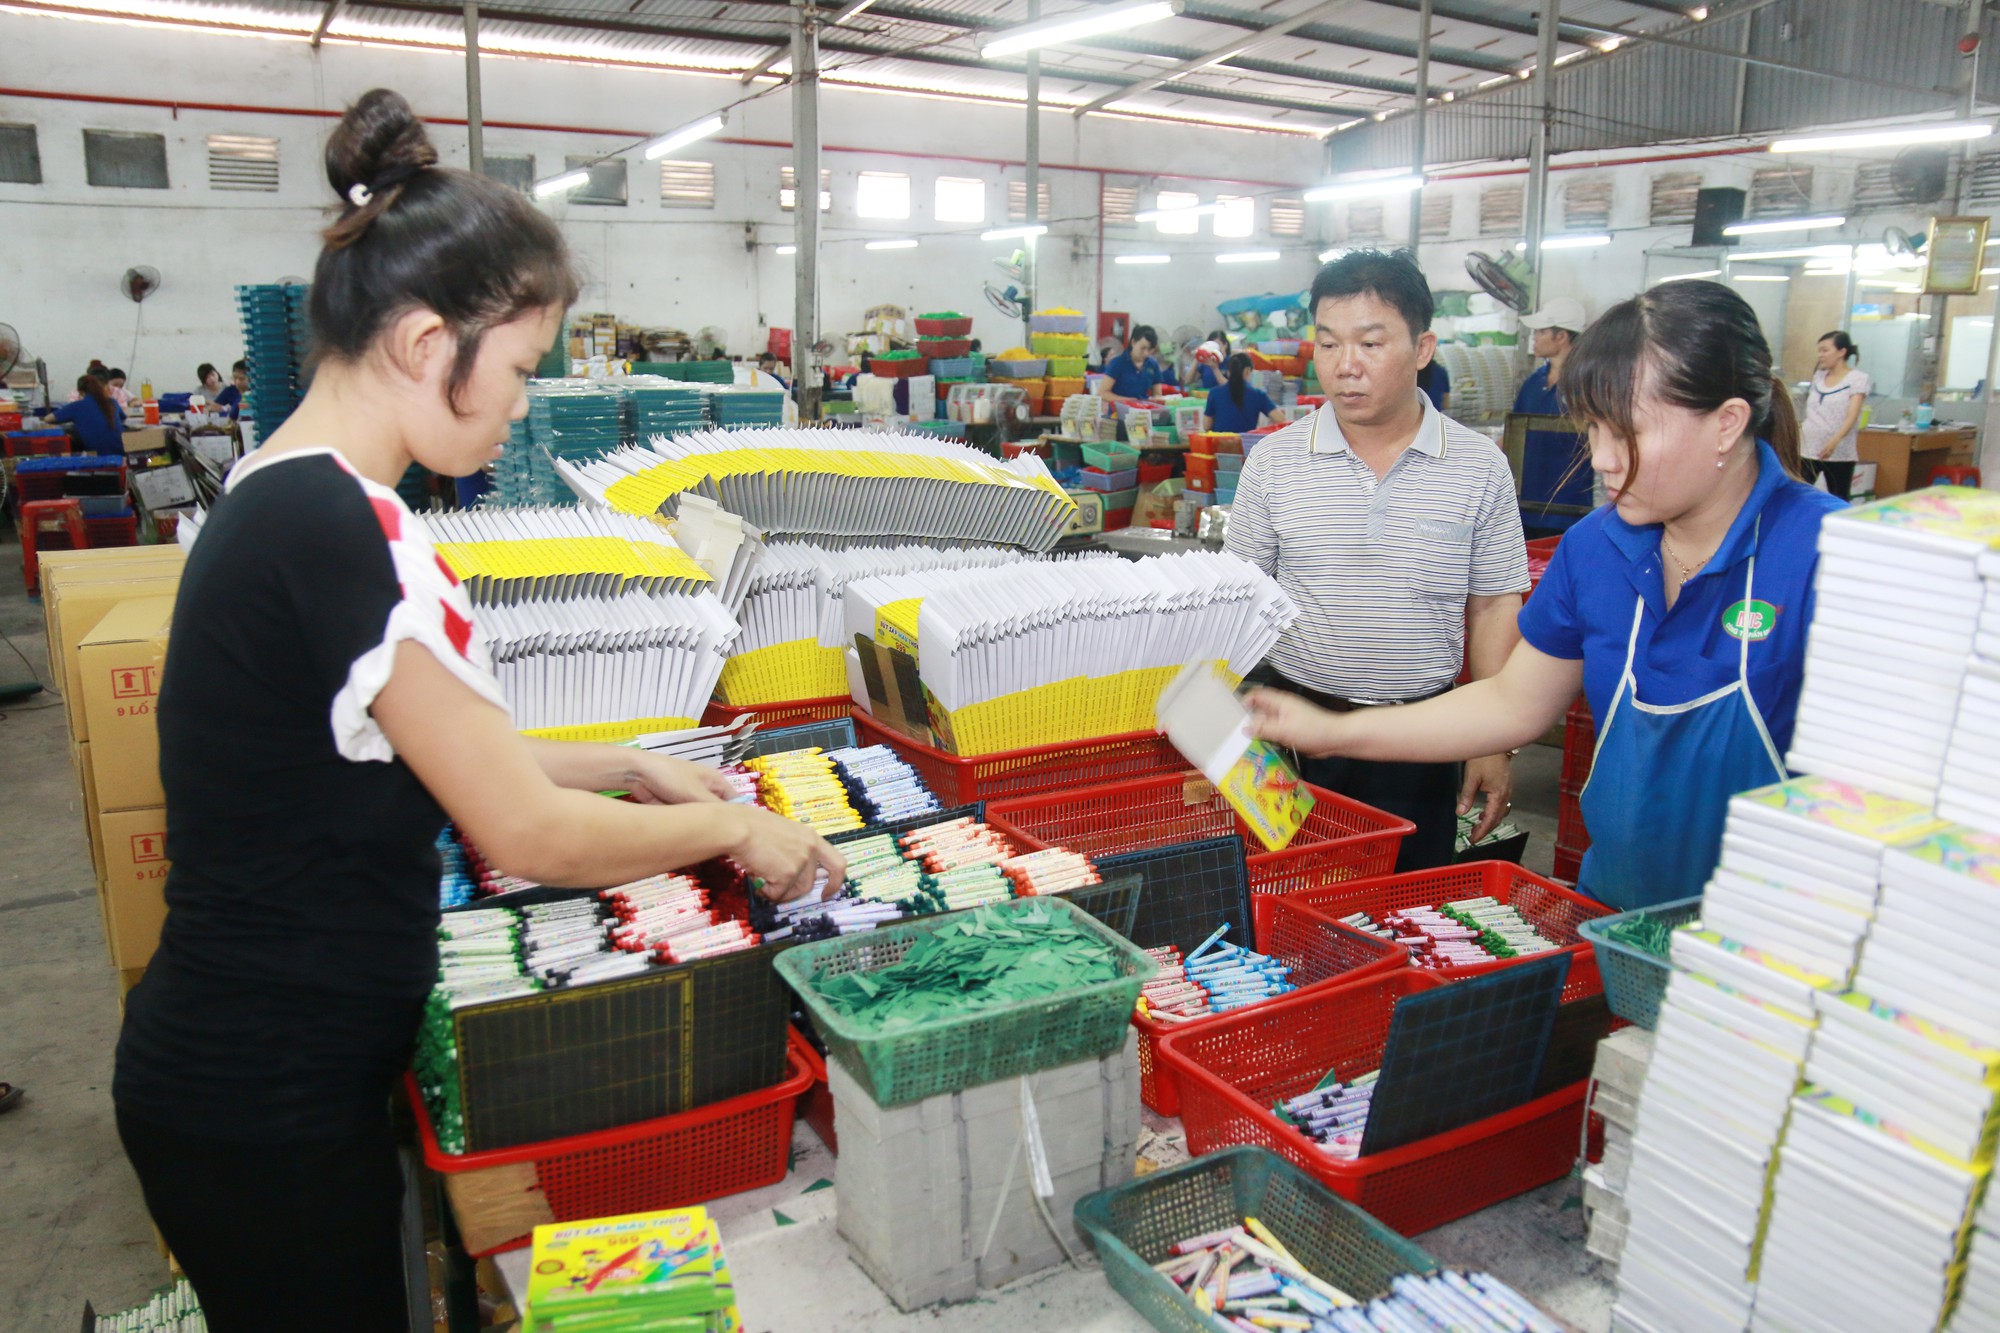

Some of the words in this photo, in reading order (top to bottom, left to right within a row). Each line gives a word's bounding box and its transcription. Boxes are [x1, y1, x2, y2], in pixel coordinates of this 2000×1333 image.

[116, 707, 125, 717] 9
[130, 700, 150, 716] LỐ
[136, 871, 144, 880] 9
